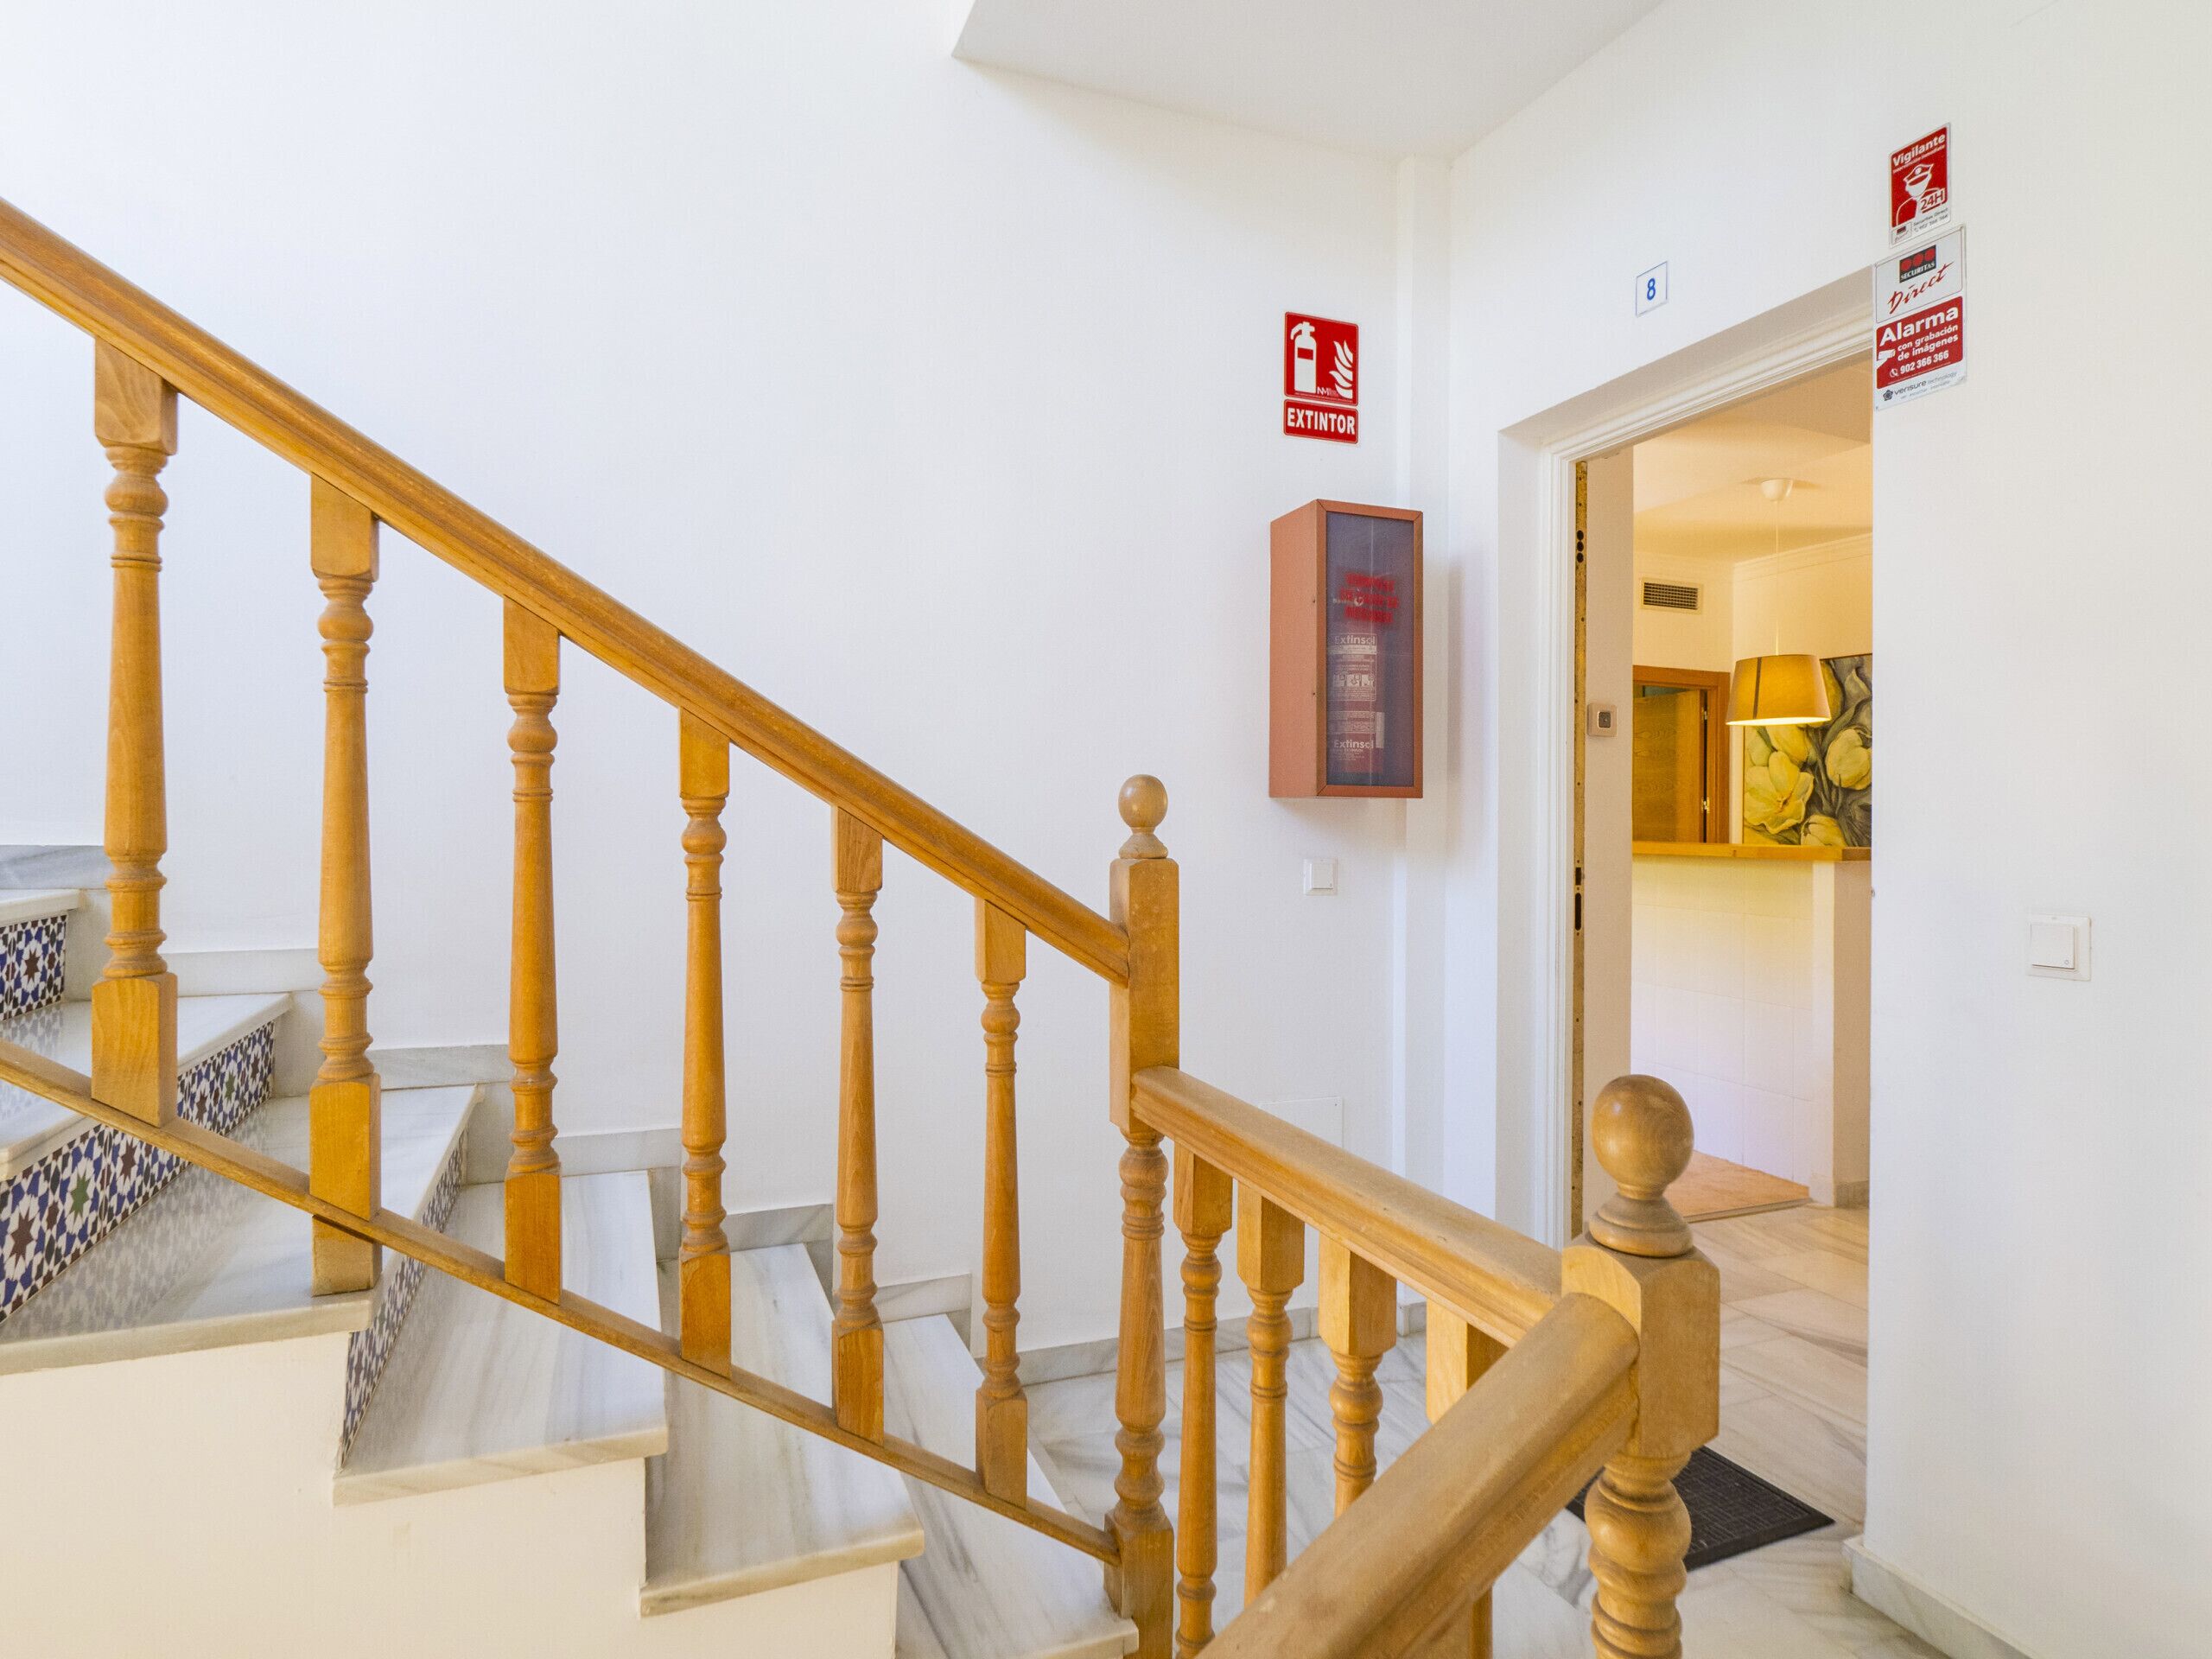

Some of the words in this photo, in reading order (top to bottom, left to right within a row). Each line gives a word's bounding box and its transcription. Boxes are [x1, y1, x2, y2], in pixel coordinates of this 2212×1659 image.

[1892, 134, 1946, 167] Vigilante
[1921, 189, 1944, 209] 24H
[1900, 262, 1936, 280] SECURITAS
[1646, 277, 1656, 301] 8
[1887, 262, 1954, 315] Direct
[1879, 306, 1959, 346] Alarma
[1897, 340, 1913, 353] con
[1915, 325, 1958, 347] grabación
[1897, 350, 1910, 361] de
[1912, 334, 1958, 357] imágenes
[1900, 362, 1916, 375] 902
[1916, 356, 1932, 370] 366
[1934, 350, 1949, 364] 366
[1894, 379, 1927, 395] verisure
[1287, 408, 1356, 435] EXTINTOR
